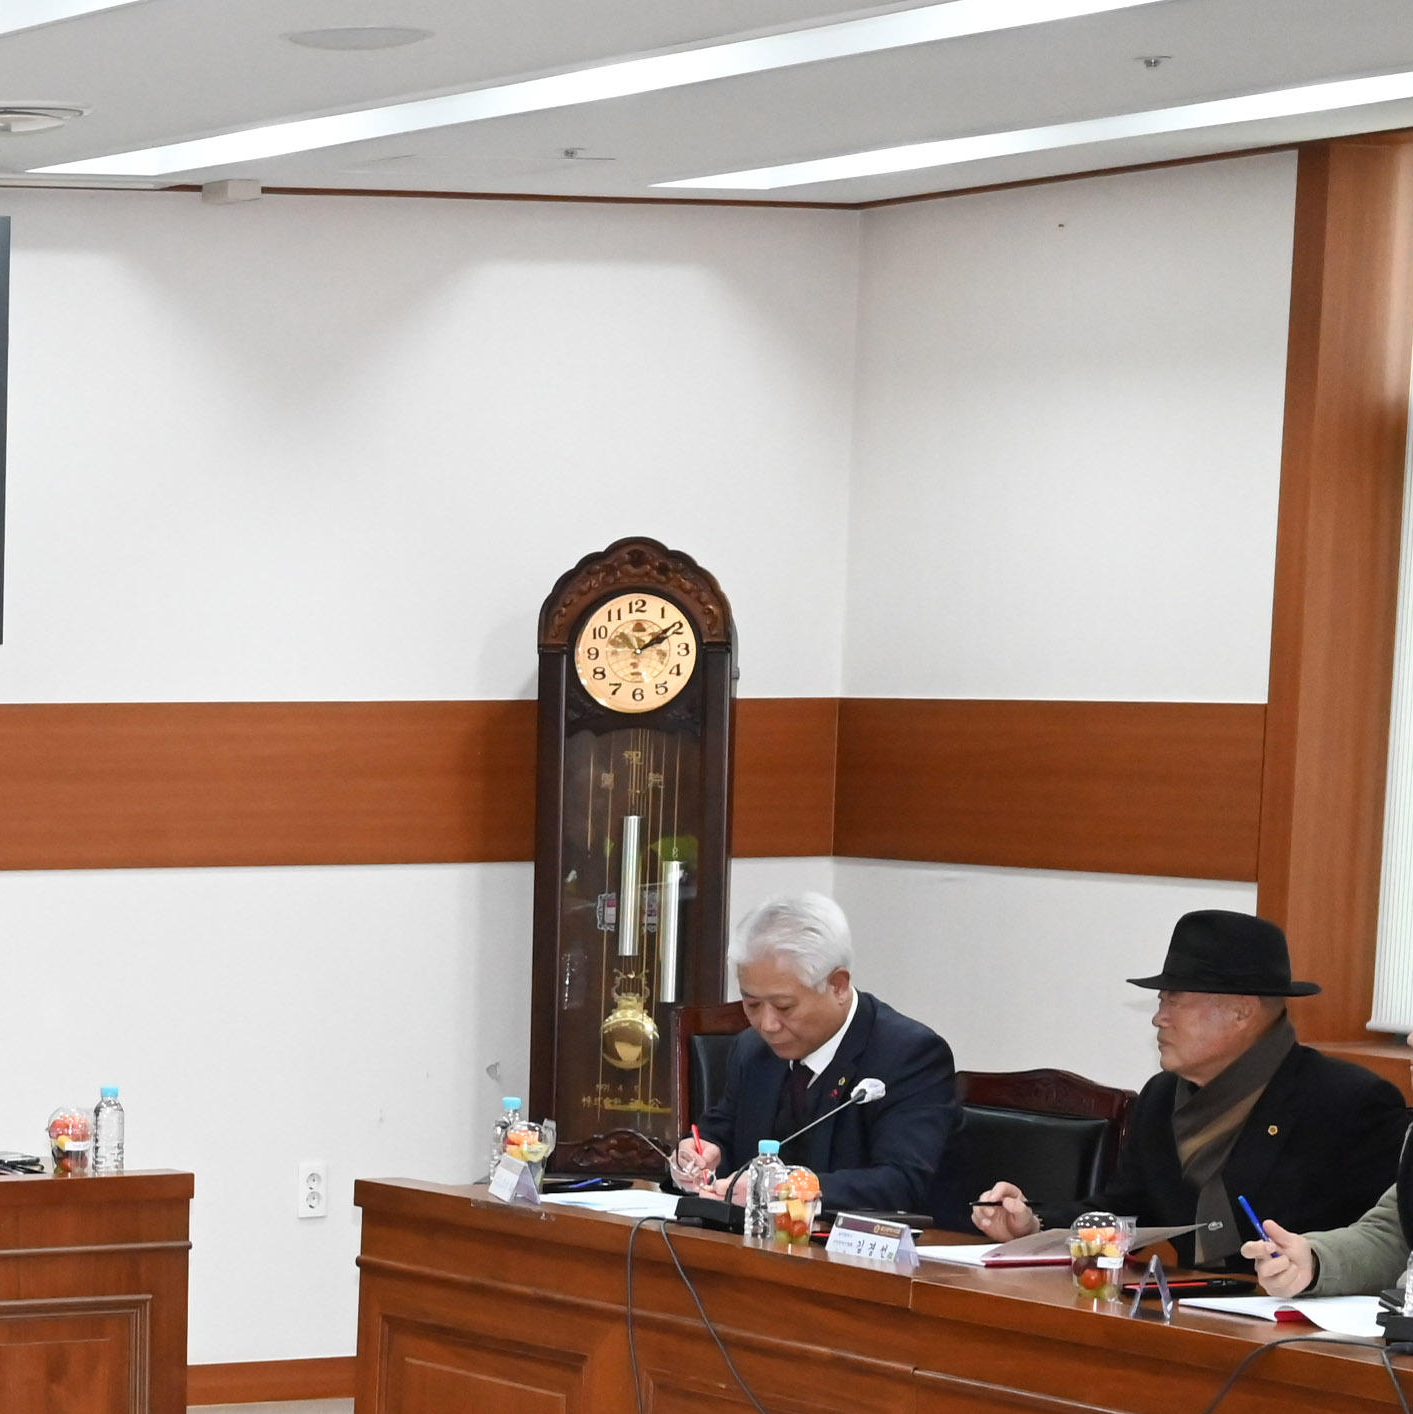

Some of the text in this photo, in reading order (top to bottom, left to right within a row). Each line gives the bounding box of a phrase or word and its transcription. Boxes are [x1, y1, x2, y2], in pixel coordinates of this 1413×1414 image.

[628, 599, 647, 614] 12
[660, 606, 666, 619] 1
[607, 608, 622, 622] 11
[593, 625, 608, 640] 10
[672, 620, 684, 635] 2
[587, 647, 599, 660] 9
[677, 643, 690, 656] 3
[592, 666, 606, 680] 8
[668, 663, 683, 676] 4
[608, 682, 622, 696] 7
[631, 688, 644, 701] 6
[654, 681, 669, 695] 5
